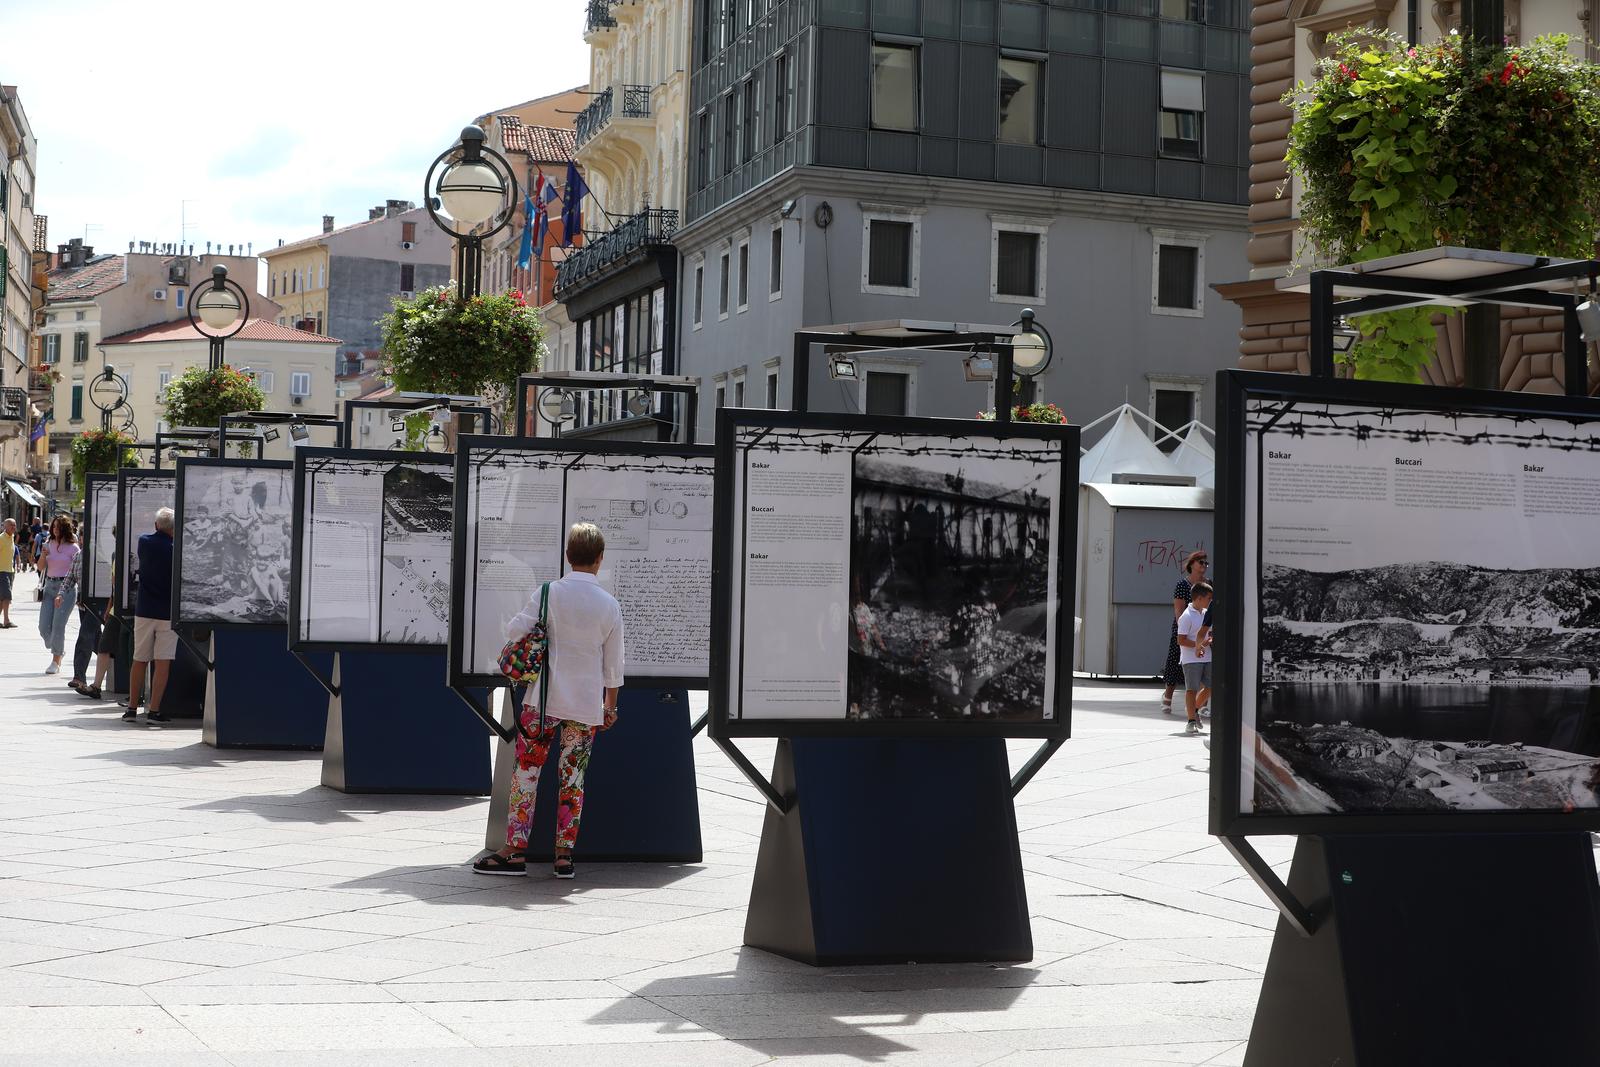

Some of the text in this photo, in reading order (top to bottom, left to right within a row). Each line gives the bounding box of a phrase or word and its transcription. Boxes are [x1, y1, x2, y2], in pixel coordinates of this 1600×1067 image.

[1268, 451, 1292, 460] Bakar
[1395, 457, 1422, 466] Buccari
[1523, 464, 1544, 473] Bakar
